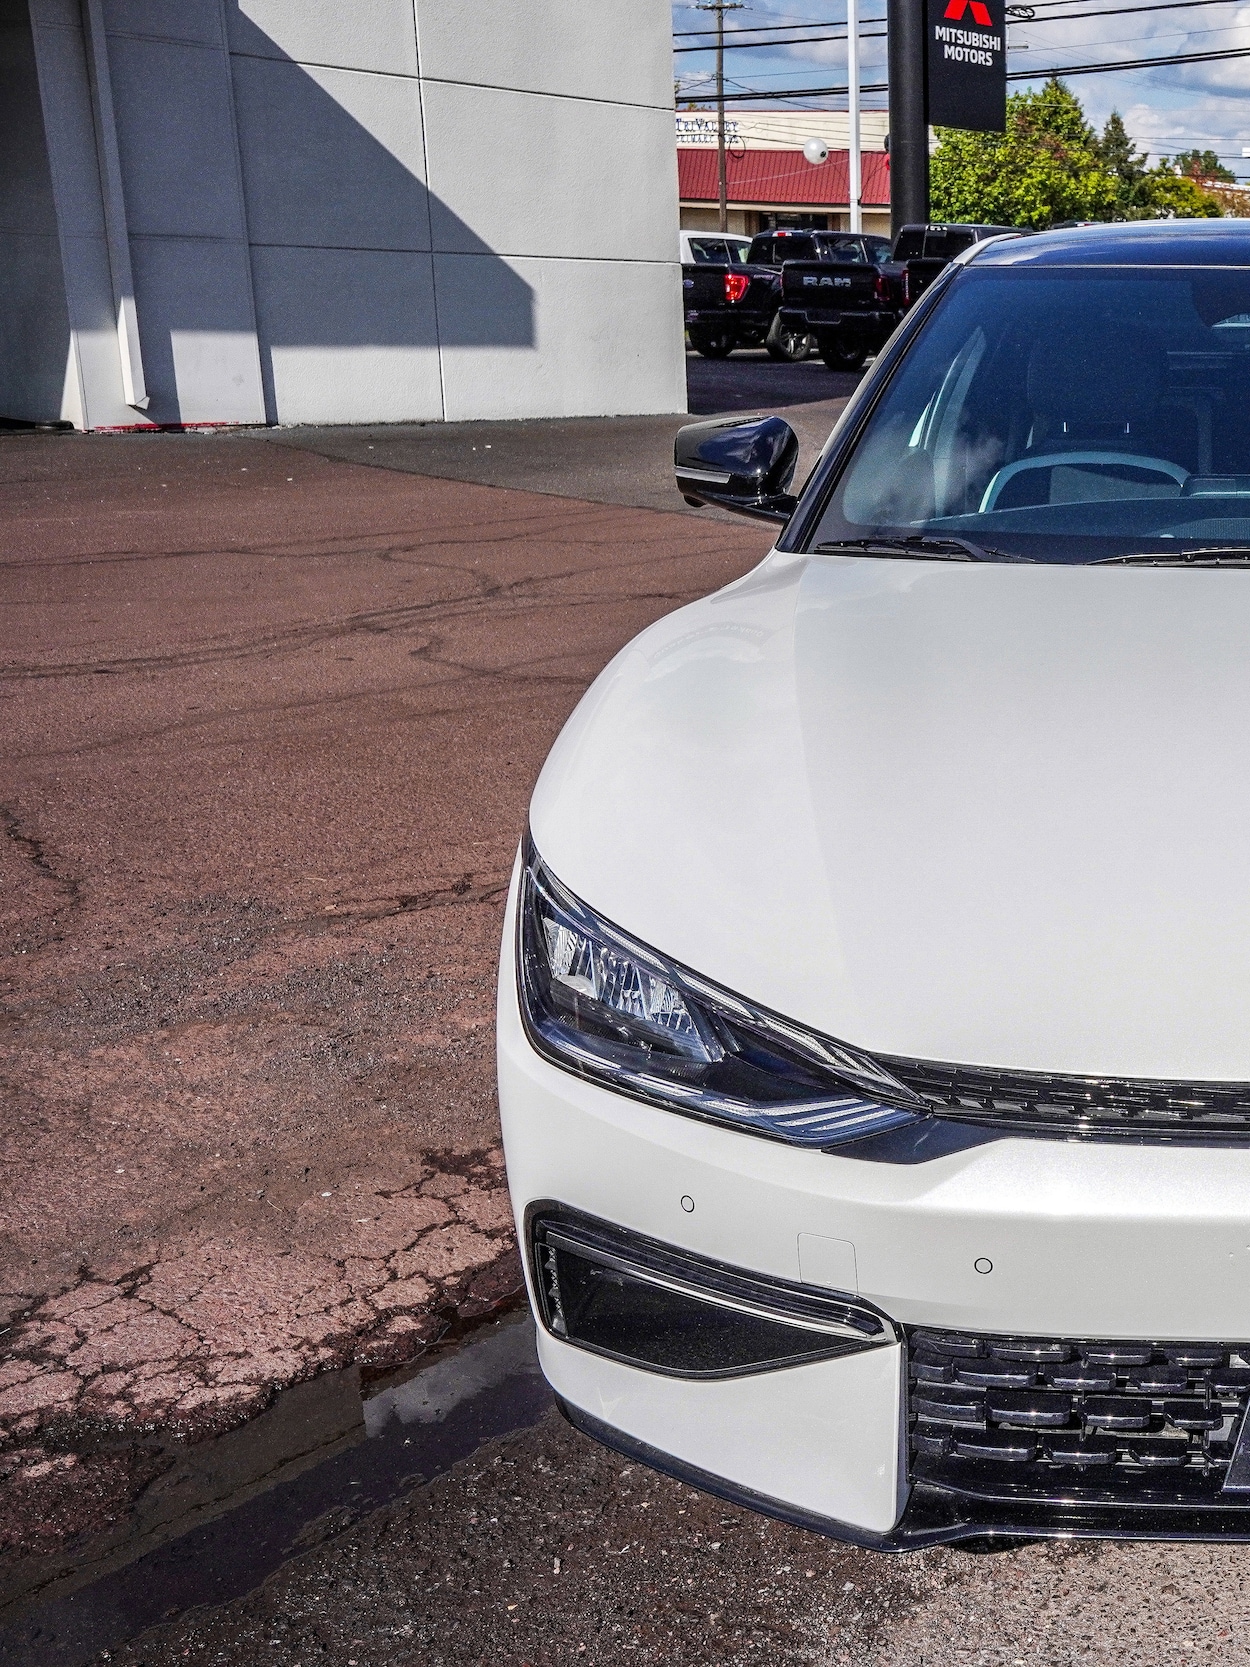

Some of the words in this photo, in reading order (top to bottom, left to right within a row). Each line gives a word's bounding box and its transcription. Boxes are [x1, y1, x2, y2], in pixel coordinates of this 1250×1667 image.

[935, 25, 1001, 51] MITSUBISHI
[944, 44, 993, 67] MOTORS
[802, 276, 851, 287] RAM
